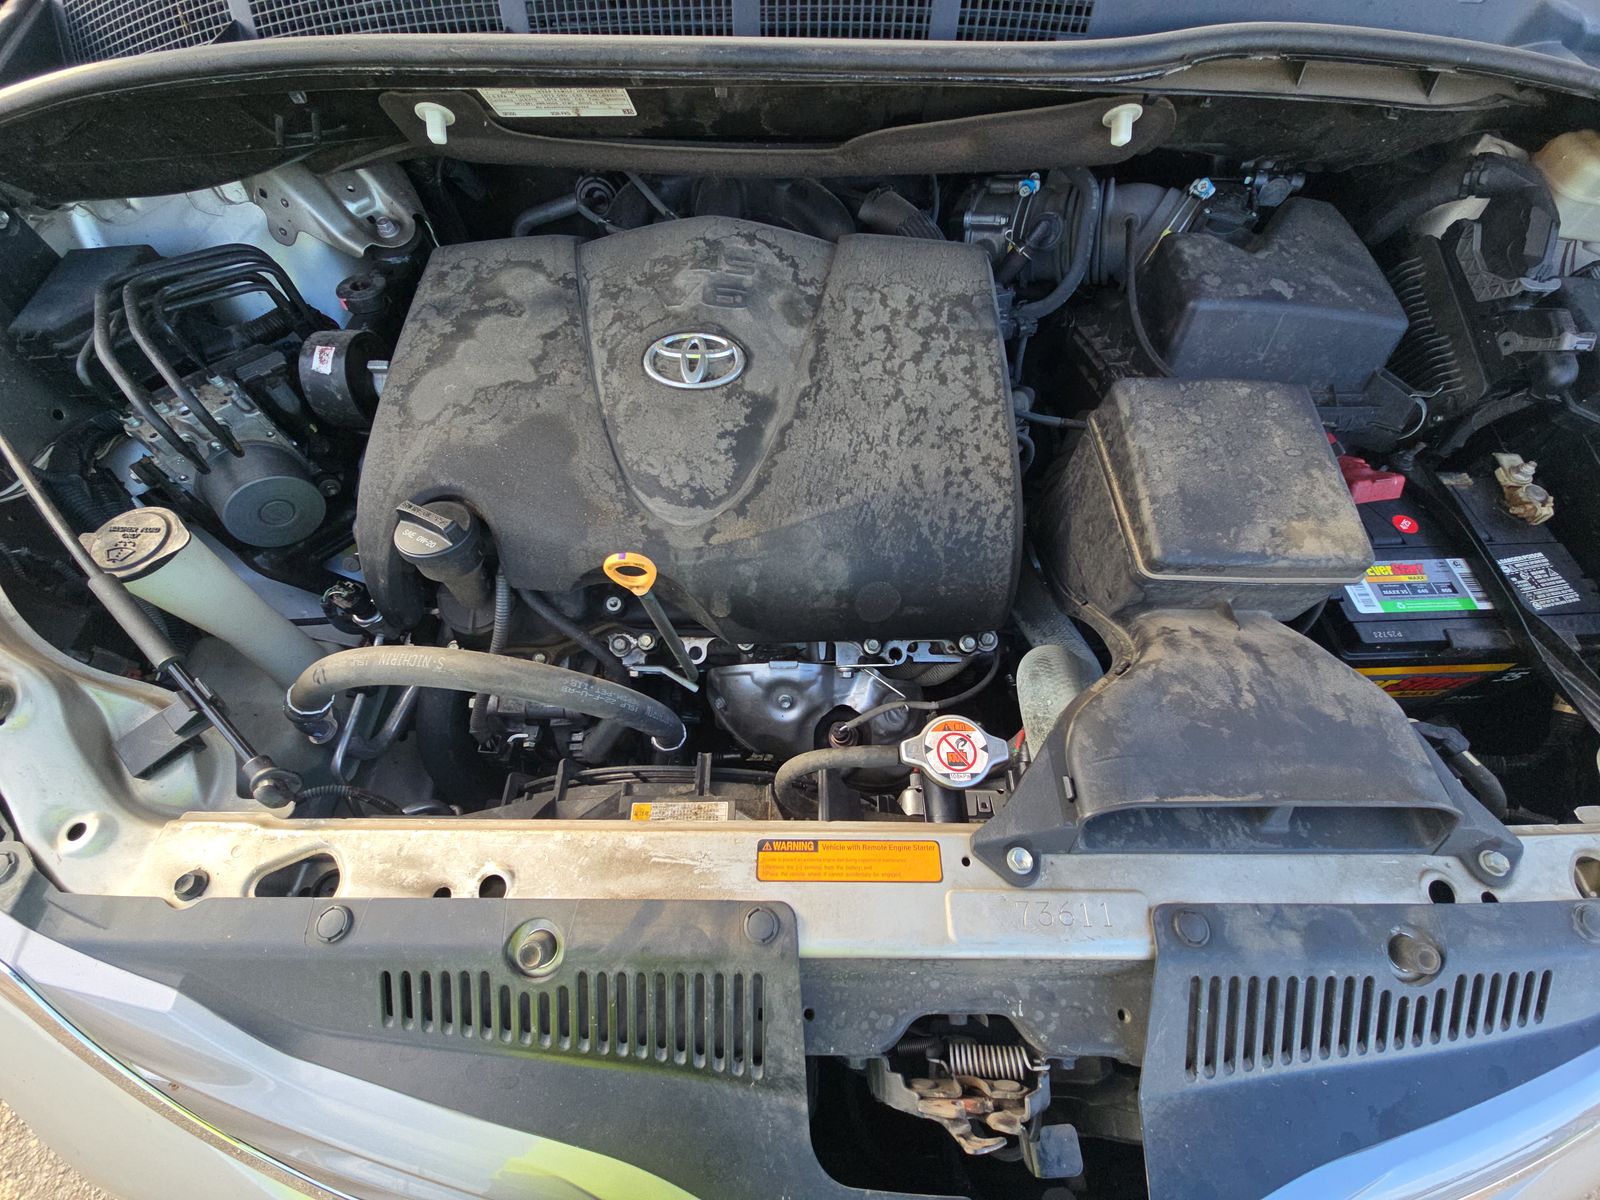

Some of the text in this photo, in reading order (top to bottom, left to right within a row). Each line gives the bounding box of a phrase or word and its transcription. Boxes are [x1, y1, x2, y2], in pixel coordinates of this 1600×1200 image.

[773, 841, 815, 851] WARNING
[822, 843, 845, 851] Vehicle
[847, 843, 860, 851] with
[889, 844, 912, 853] Engine
[913, 844, 936, 852] Starter
[1015, 900, 1112, 928] 73611
